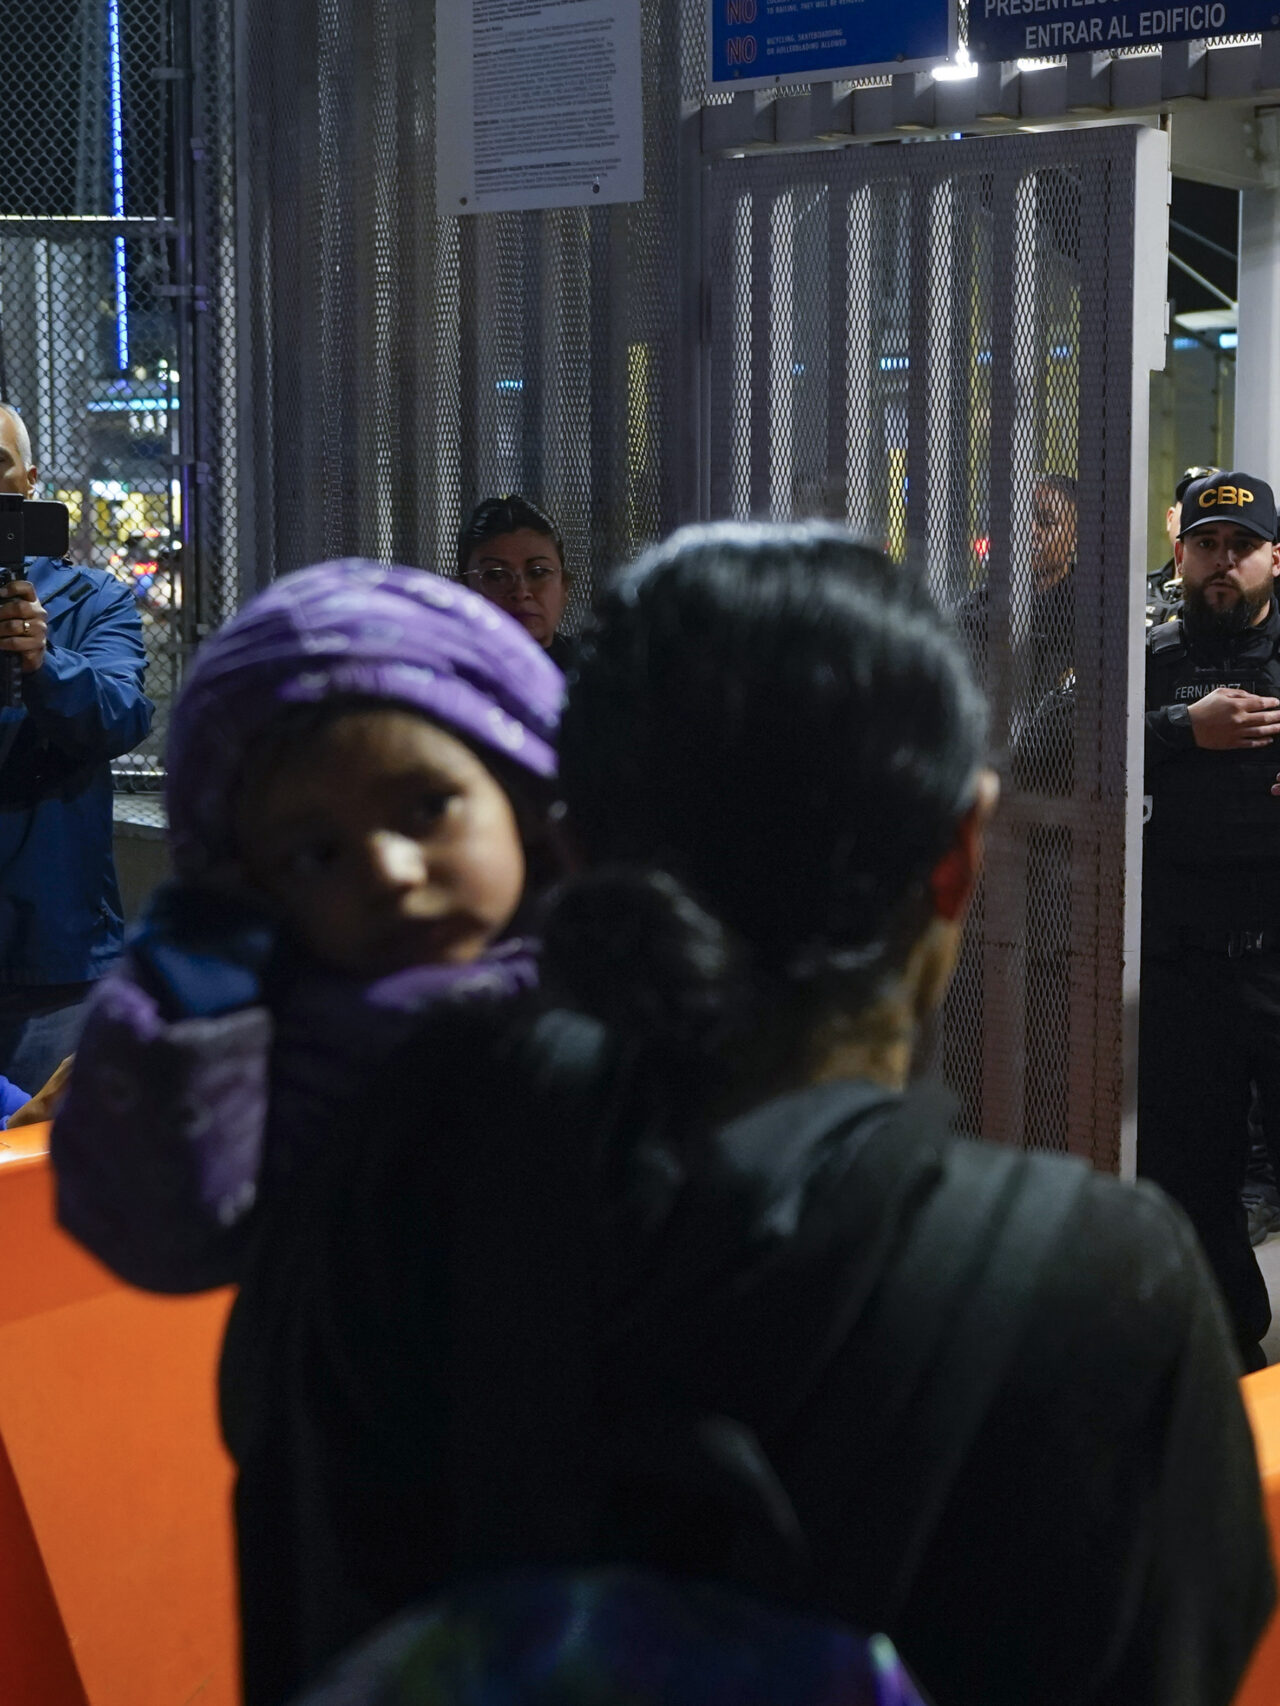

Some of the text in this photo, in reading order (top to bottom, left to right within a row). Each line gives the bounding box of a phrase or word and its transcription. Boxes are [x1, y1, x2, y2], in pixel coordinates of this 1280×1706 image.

[728, 0, 756, 25] NO
[1026, 3, 1226, 49] ENTRAR AL EDIFICIO
[728, 35, 756, 65] NO
[1199, 485, 1254, 508] CBP
